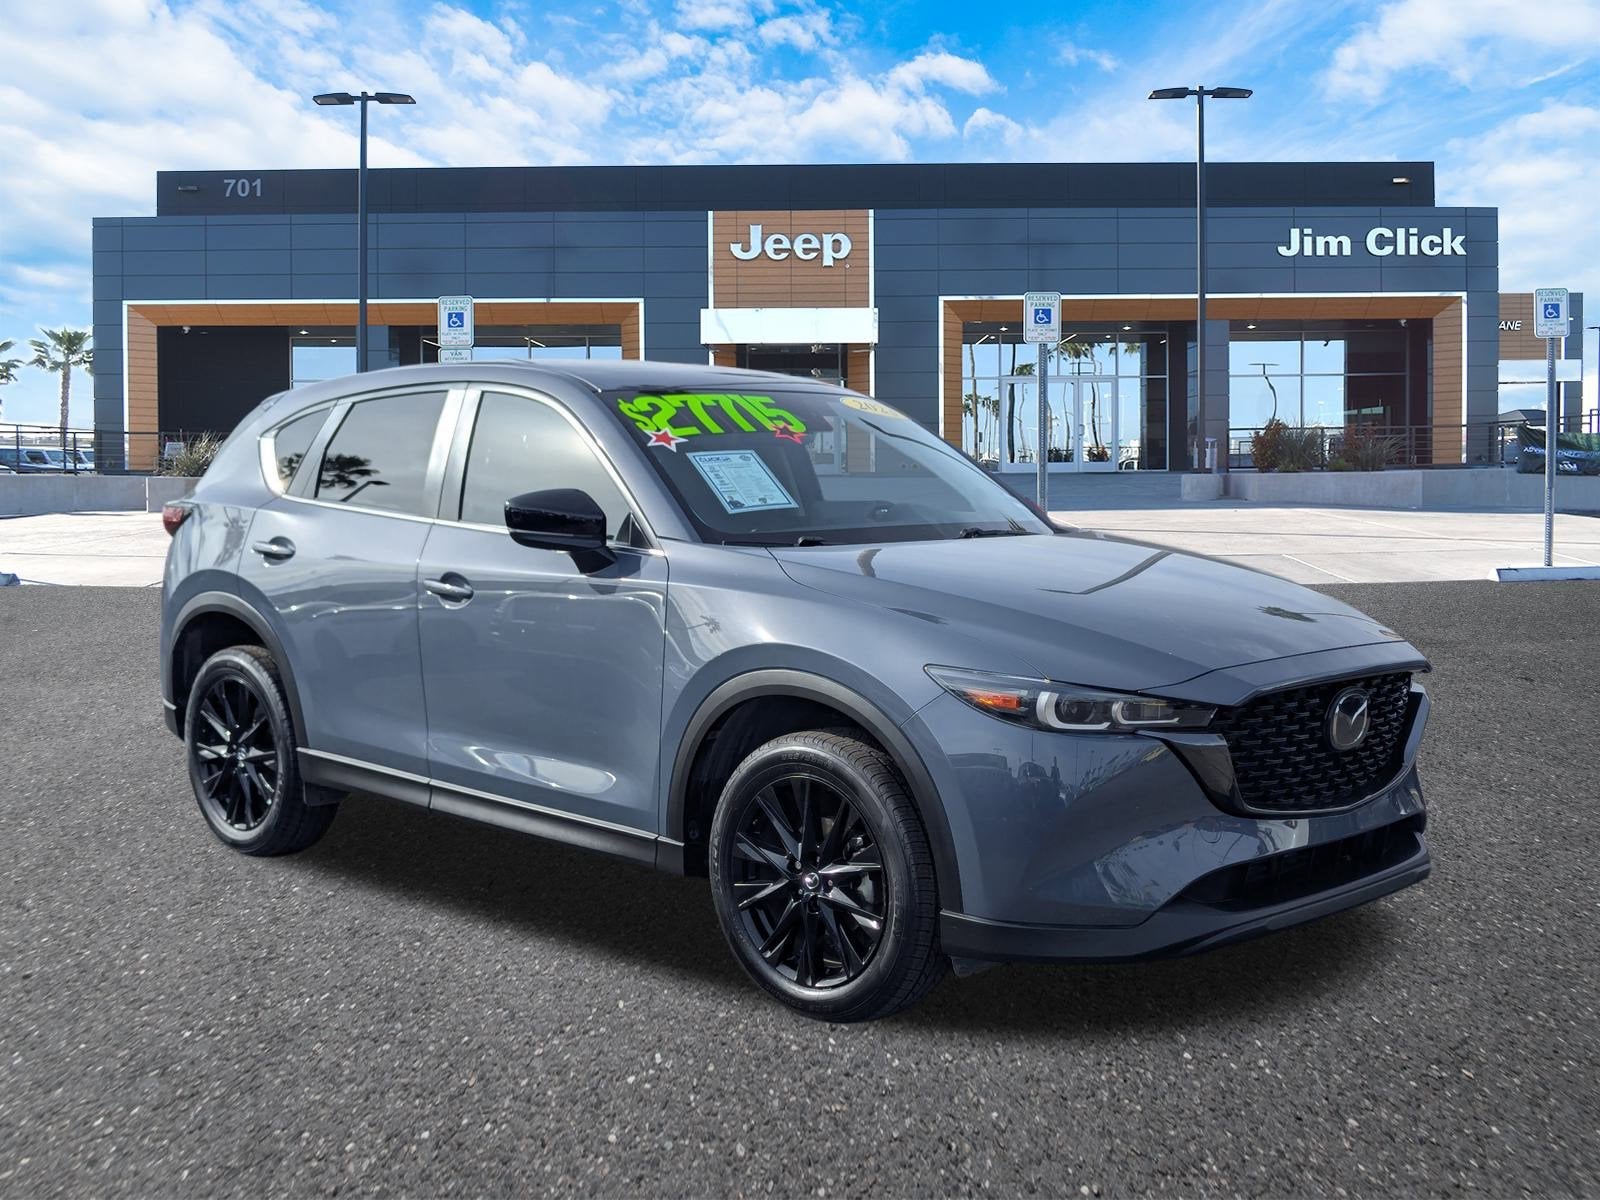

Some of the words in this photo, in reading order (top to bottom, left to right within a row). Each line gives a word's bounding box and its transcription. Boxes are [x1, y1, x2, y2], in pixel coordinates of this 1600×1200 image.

[223, 179, 262, 197] 701
[729, 224, 852, 268] Jeep
[1277, 228, 1352, 257] Jim
[1365, 227, 1467, 257] Click
